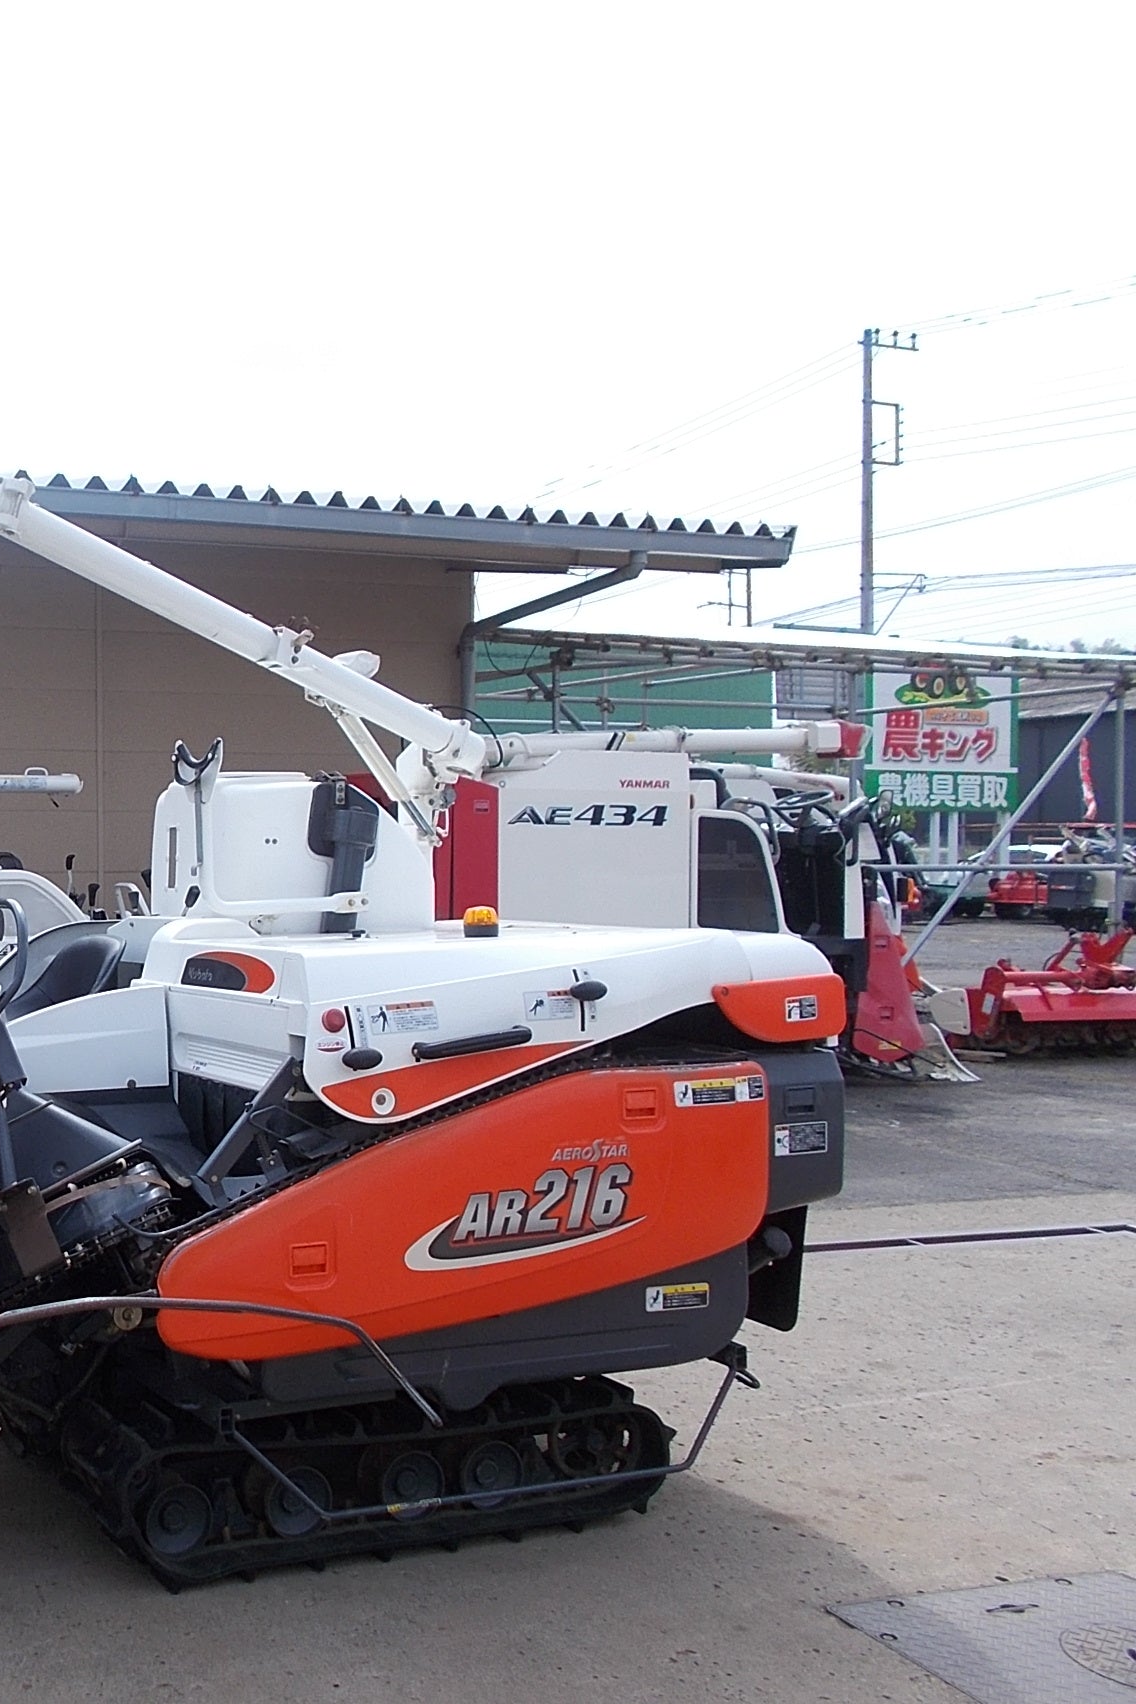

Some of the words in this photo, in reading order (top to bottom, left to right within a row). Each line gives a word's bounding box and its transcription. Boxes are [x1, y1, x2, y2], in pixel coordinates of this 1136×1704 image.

[882, 710, 996, 762] 農キング
[619, 779, 670, 789] YANMAR
[878, 772, 1008, 808] 農機具買取
[507, 804, 668, 826] AE434
[551, 1138, 628, 1162] AEROSTAR
[450, 1162, 633, 1244] AR216
